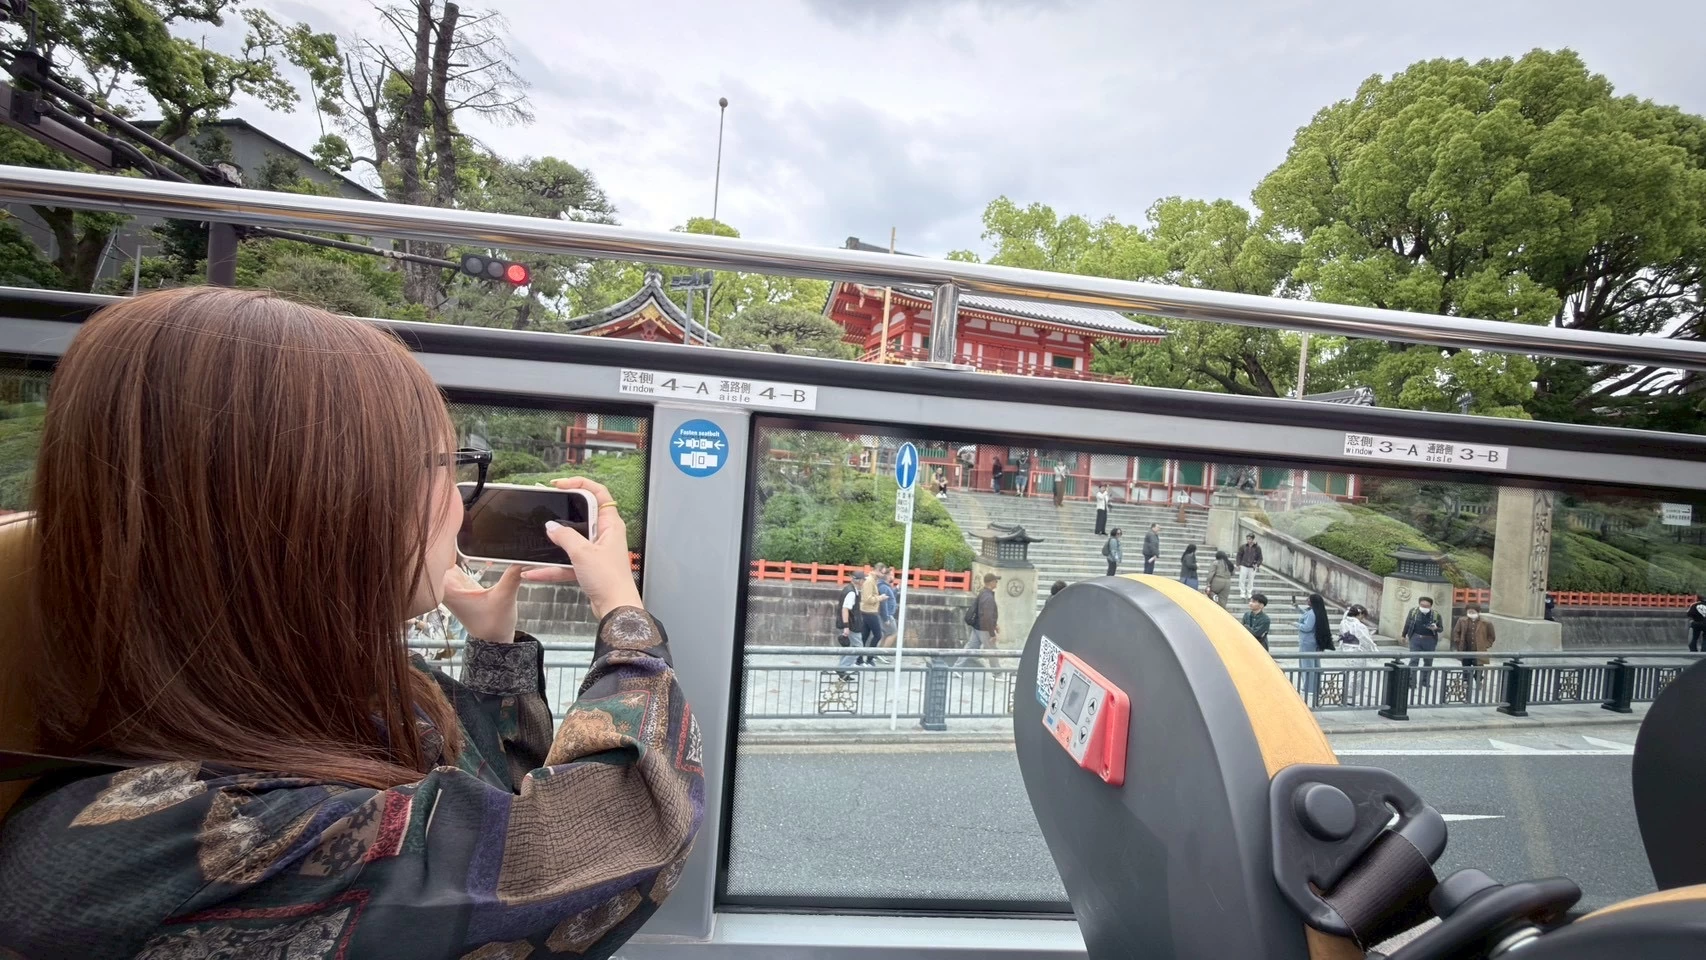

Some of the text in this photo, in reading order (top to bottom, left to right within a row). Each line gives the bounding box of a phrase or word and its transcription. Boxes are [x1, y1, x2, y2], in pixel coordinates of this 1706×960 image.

[622, 384, 750, 403] window aisle
[623, 371, 806, 403] 窓側 4-A 通路側 4-B
[1345, 447, 1452, 463] window aisle
[1347, 435, 1499, 463] 窓側 3-A 通路側 3-B
